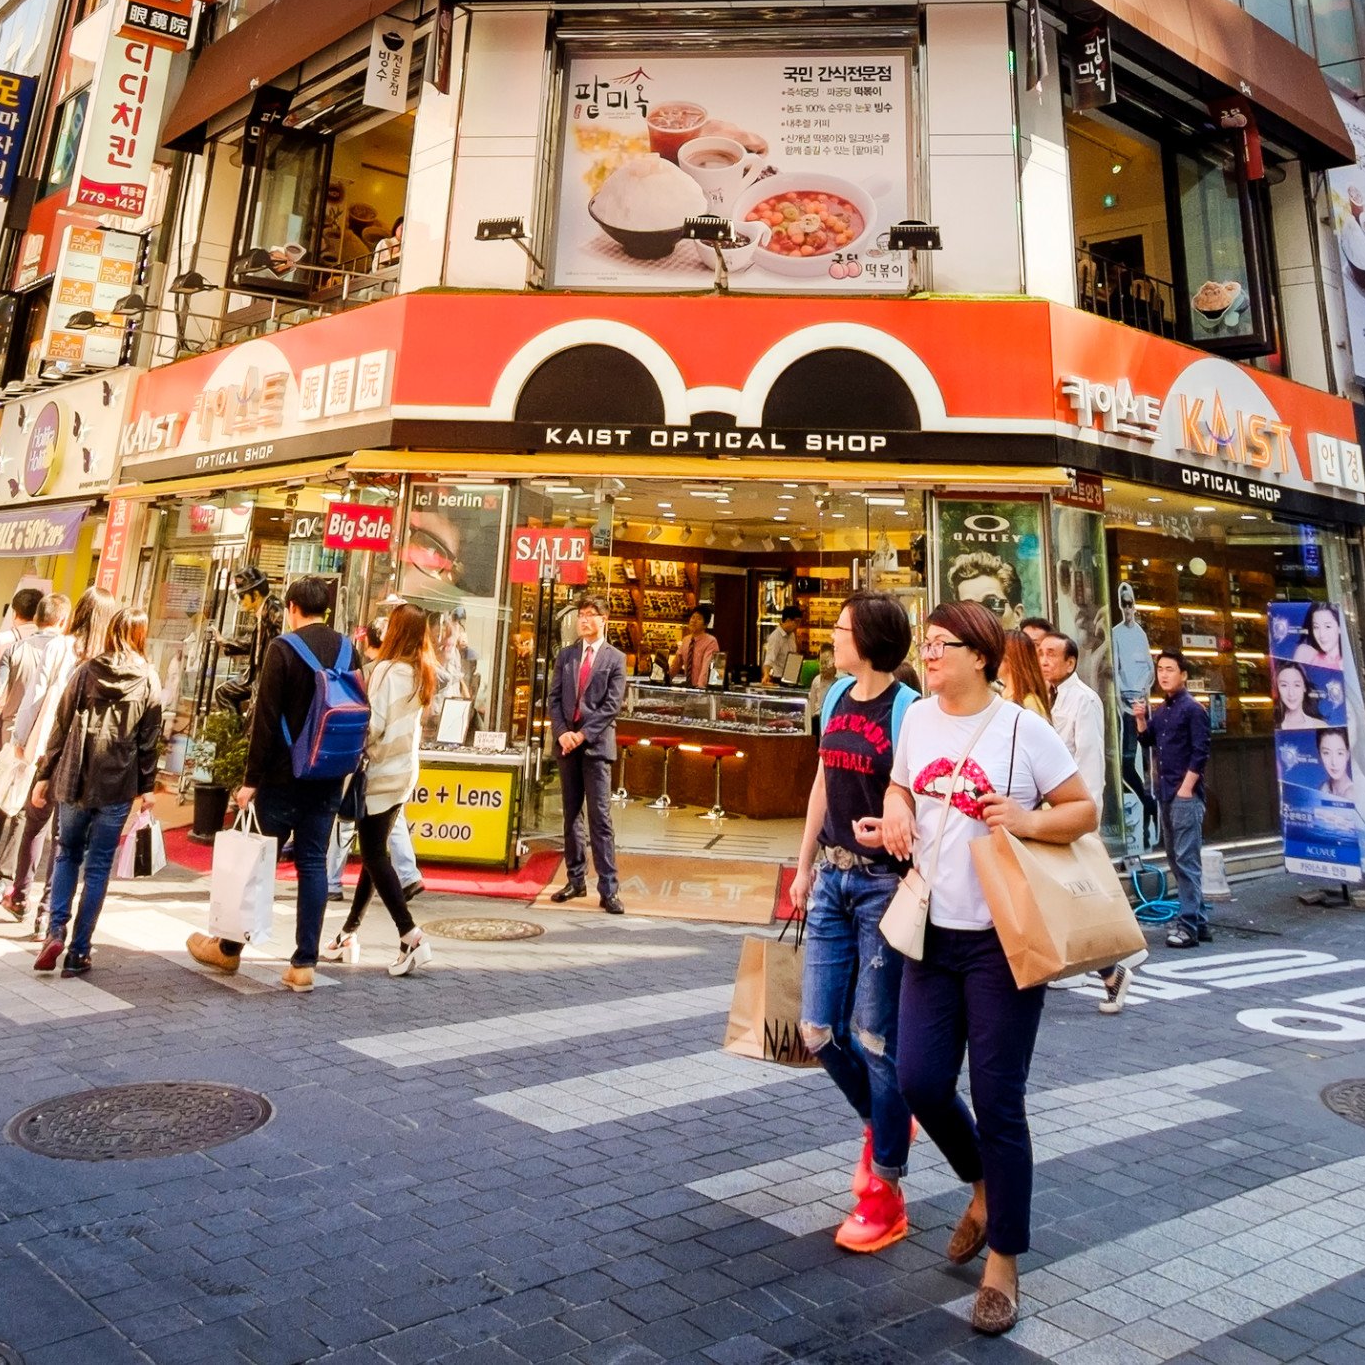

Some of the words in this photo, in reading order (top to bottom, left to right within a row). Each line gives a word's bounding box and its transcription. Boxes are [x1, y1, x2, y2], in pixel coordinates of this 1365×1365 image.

[129, 4, 189, 36] 眼鏡院
[376, 50, 391, 82] 빙수
[783, 66, 813, 83] 국민
[817, 65, 892, 83] 간식전문점
[853, 86, 883, 97] 떡볶이
[107, 41, 154, 169] 디디치킨
[805, 104, 826, 113] 100%
[874, 103, 893, 113] 빙수
[80, 189, 144, 212] 779-1421
[865, 263, 903, 278] 떡볶이
[301, 362, 381, 412] 眼鏡院
[120, 410, 181, 456] KAIST
[545, 426, 632, 447] KAIST
[649, 430, 787, 452] OPTICAL
[805, 432, 888, 453] SHOP
[1177, 388, 1292, 476] KAIST
[195, 448, 239, 469] OPTICAL
[244, 444, 274, 462] SHOP
[1320, 443, 1362, 484] 안경
[1181, 468, 1243, 495] OPTICAL
[1248, 482, 1282, 503] SHOP
[437, 491, 484, 509] berlin
[328, 512, 356, 543] Big
[358, 515, 392, 540] Sale
[952, 531, 1023, 545] OAKLEY
[515, 536, 586, 562] SALE
[456, 784, 503, 808] Lens
[1305, 843, 1337, 859] ACUVUE
